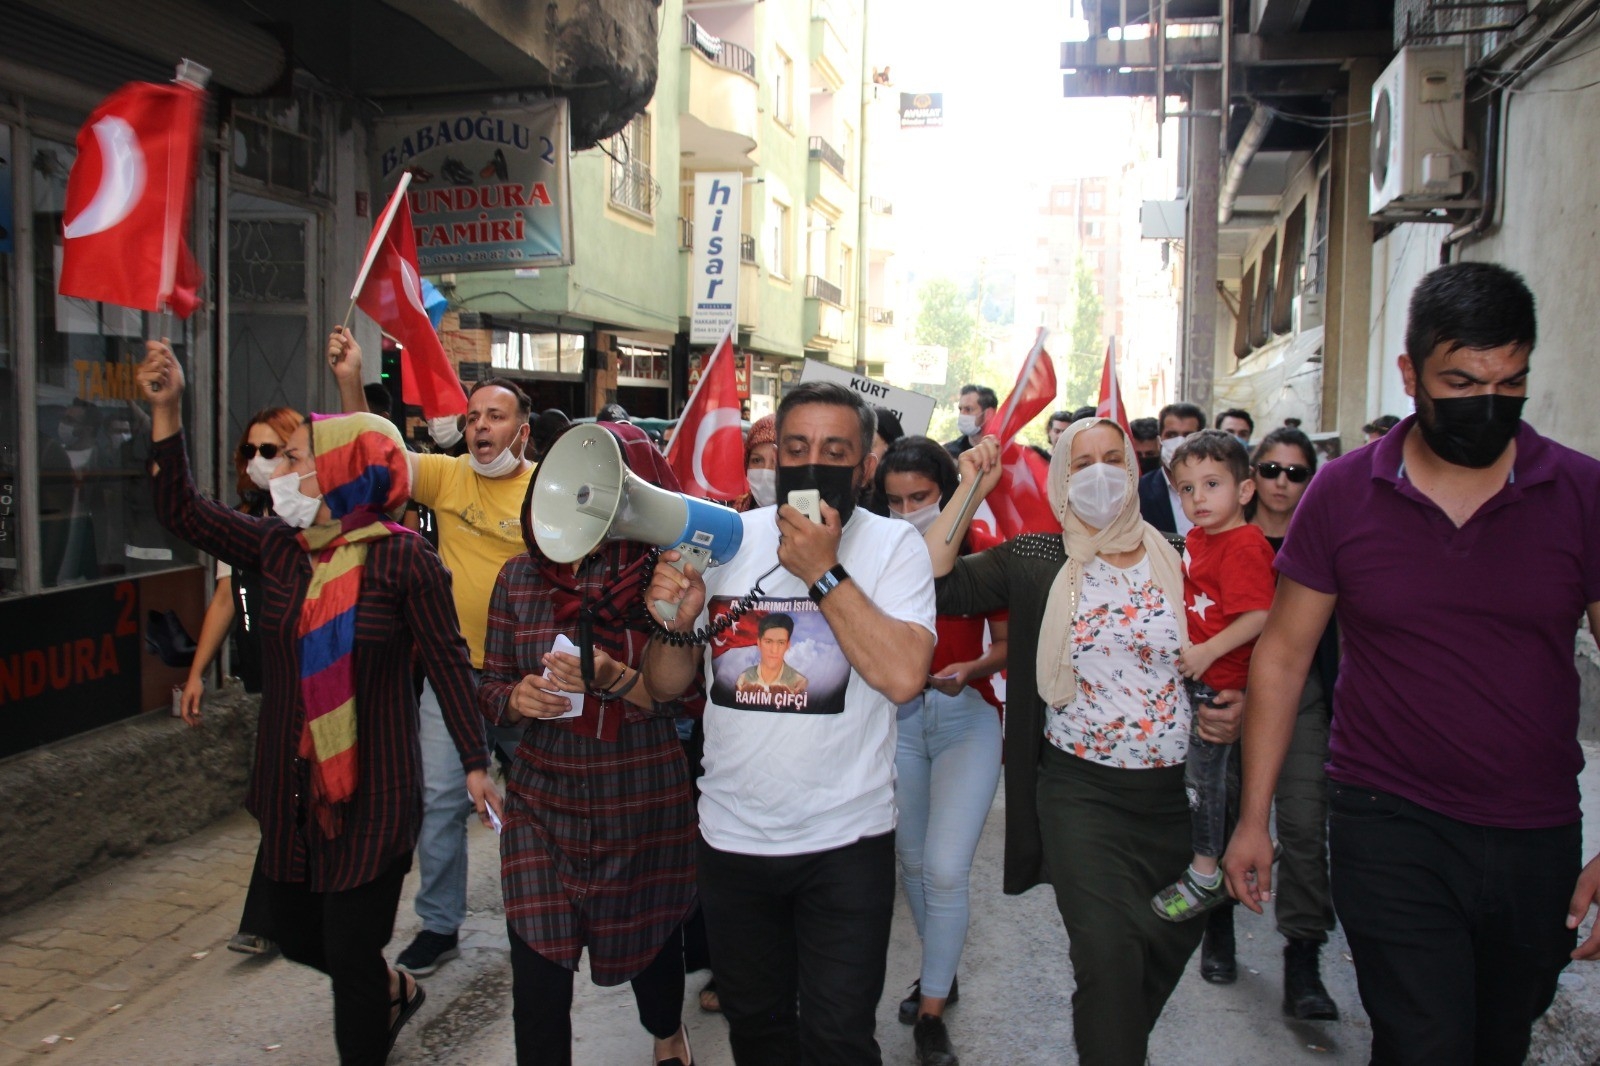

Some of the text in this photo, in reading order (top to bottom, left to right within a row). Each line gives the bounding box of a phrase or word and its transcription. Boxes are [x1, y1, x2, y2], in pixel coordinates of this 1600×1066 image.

[380, 112, 555, 178] BABAOĞLU 2
[387, 182, 552, 214] UNDURA
[413, 211, 526, 248] TAMİRİ
[705, 179, 731, 299] hisar
[850, 377, 890, 399] KÜRT
[115, 582, 137, 637] 2
[794, 599, 819, 612] İSTİYO
[736, 691, 808, 710] RAHİM ÇİFÇİ
